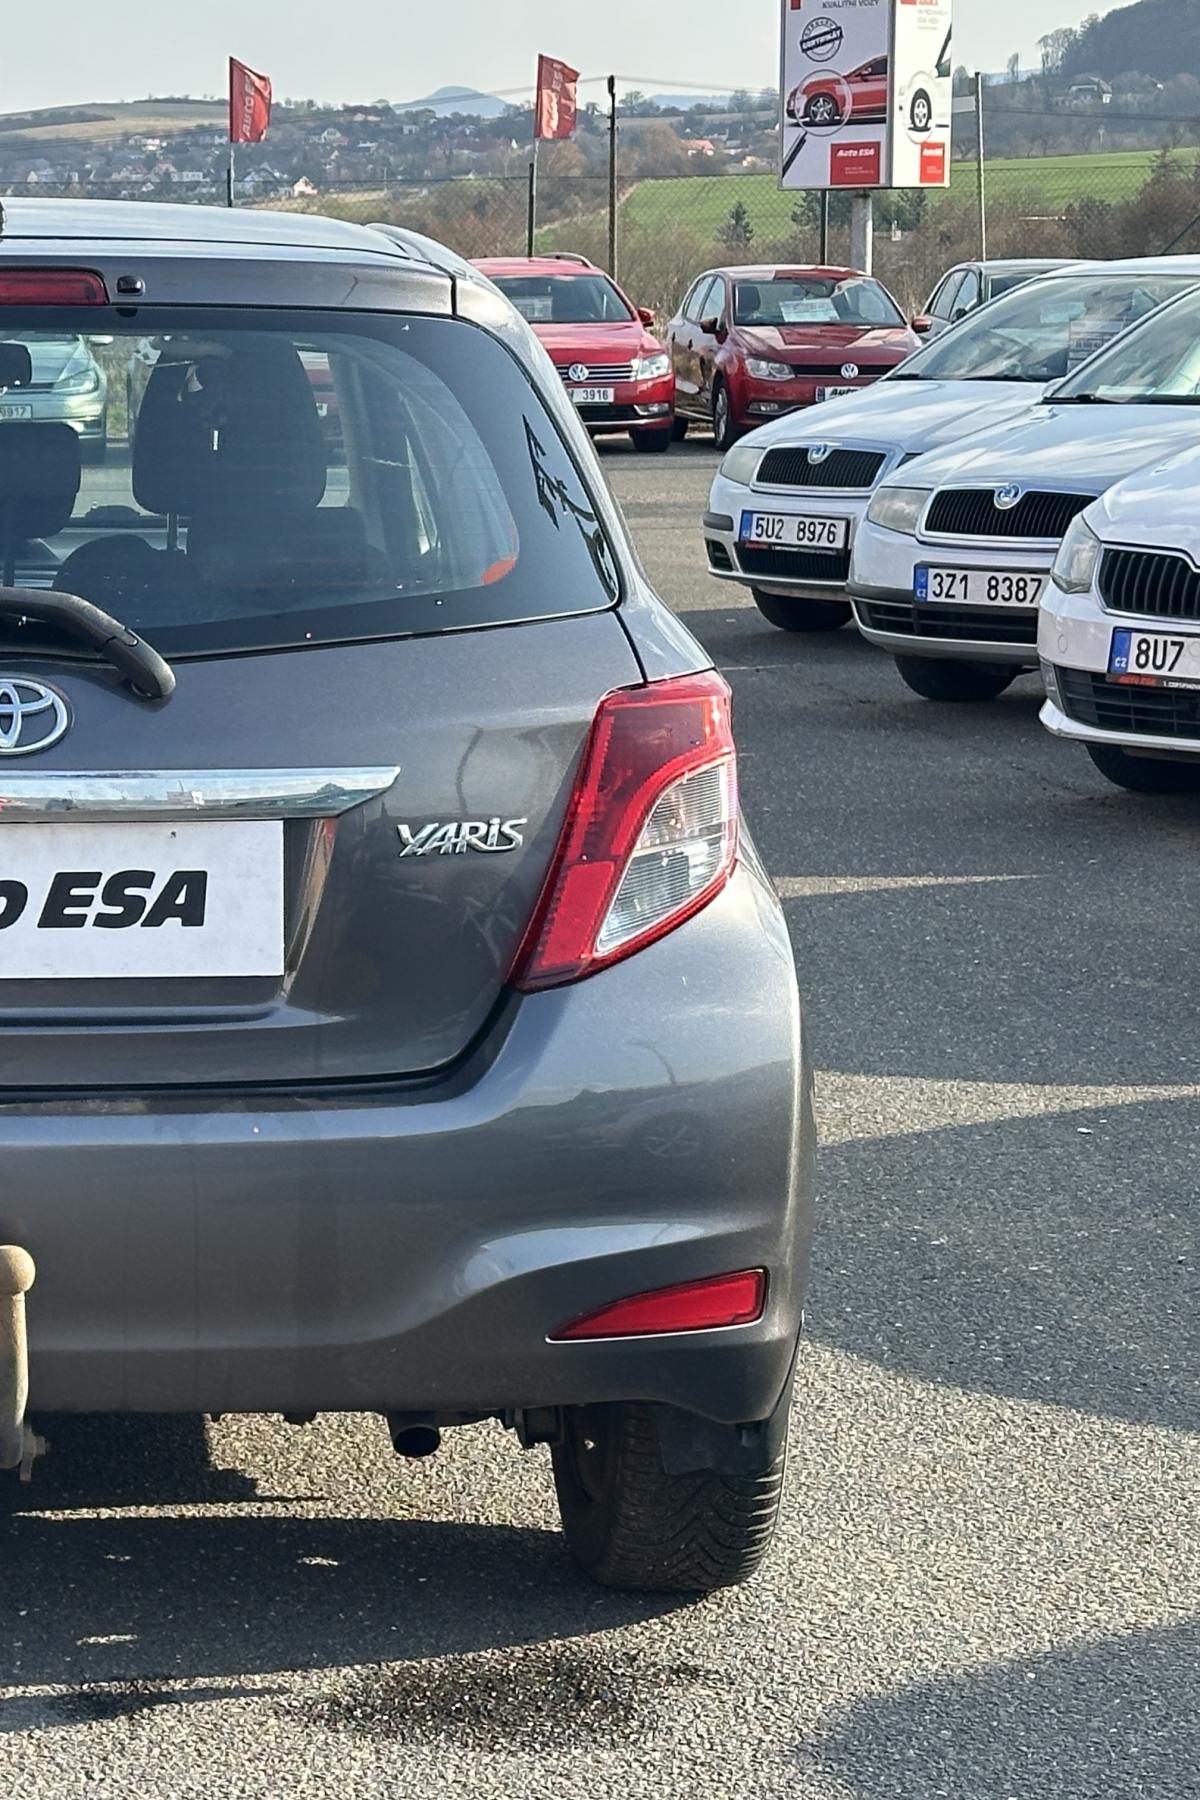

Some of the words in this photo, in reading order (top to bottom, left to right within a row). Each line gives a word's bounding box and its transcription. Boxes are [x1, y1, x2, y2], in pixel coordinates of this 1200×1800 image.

[582, 389, 609, 401] 3916
[755, 517, 785, 540] 5U2
[796, 520, 838, 544] 8976
[932, 572, 968, 600] 3Z1
[986, 575, 1042, 604] 8387
[1135, 637, 1184, 672] 8U7
[37, 869, 209, 929] ESA
